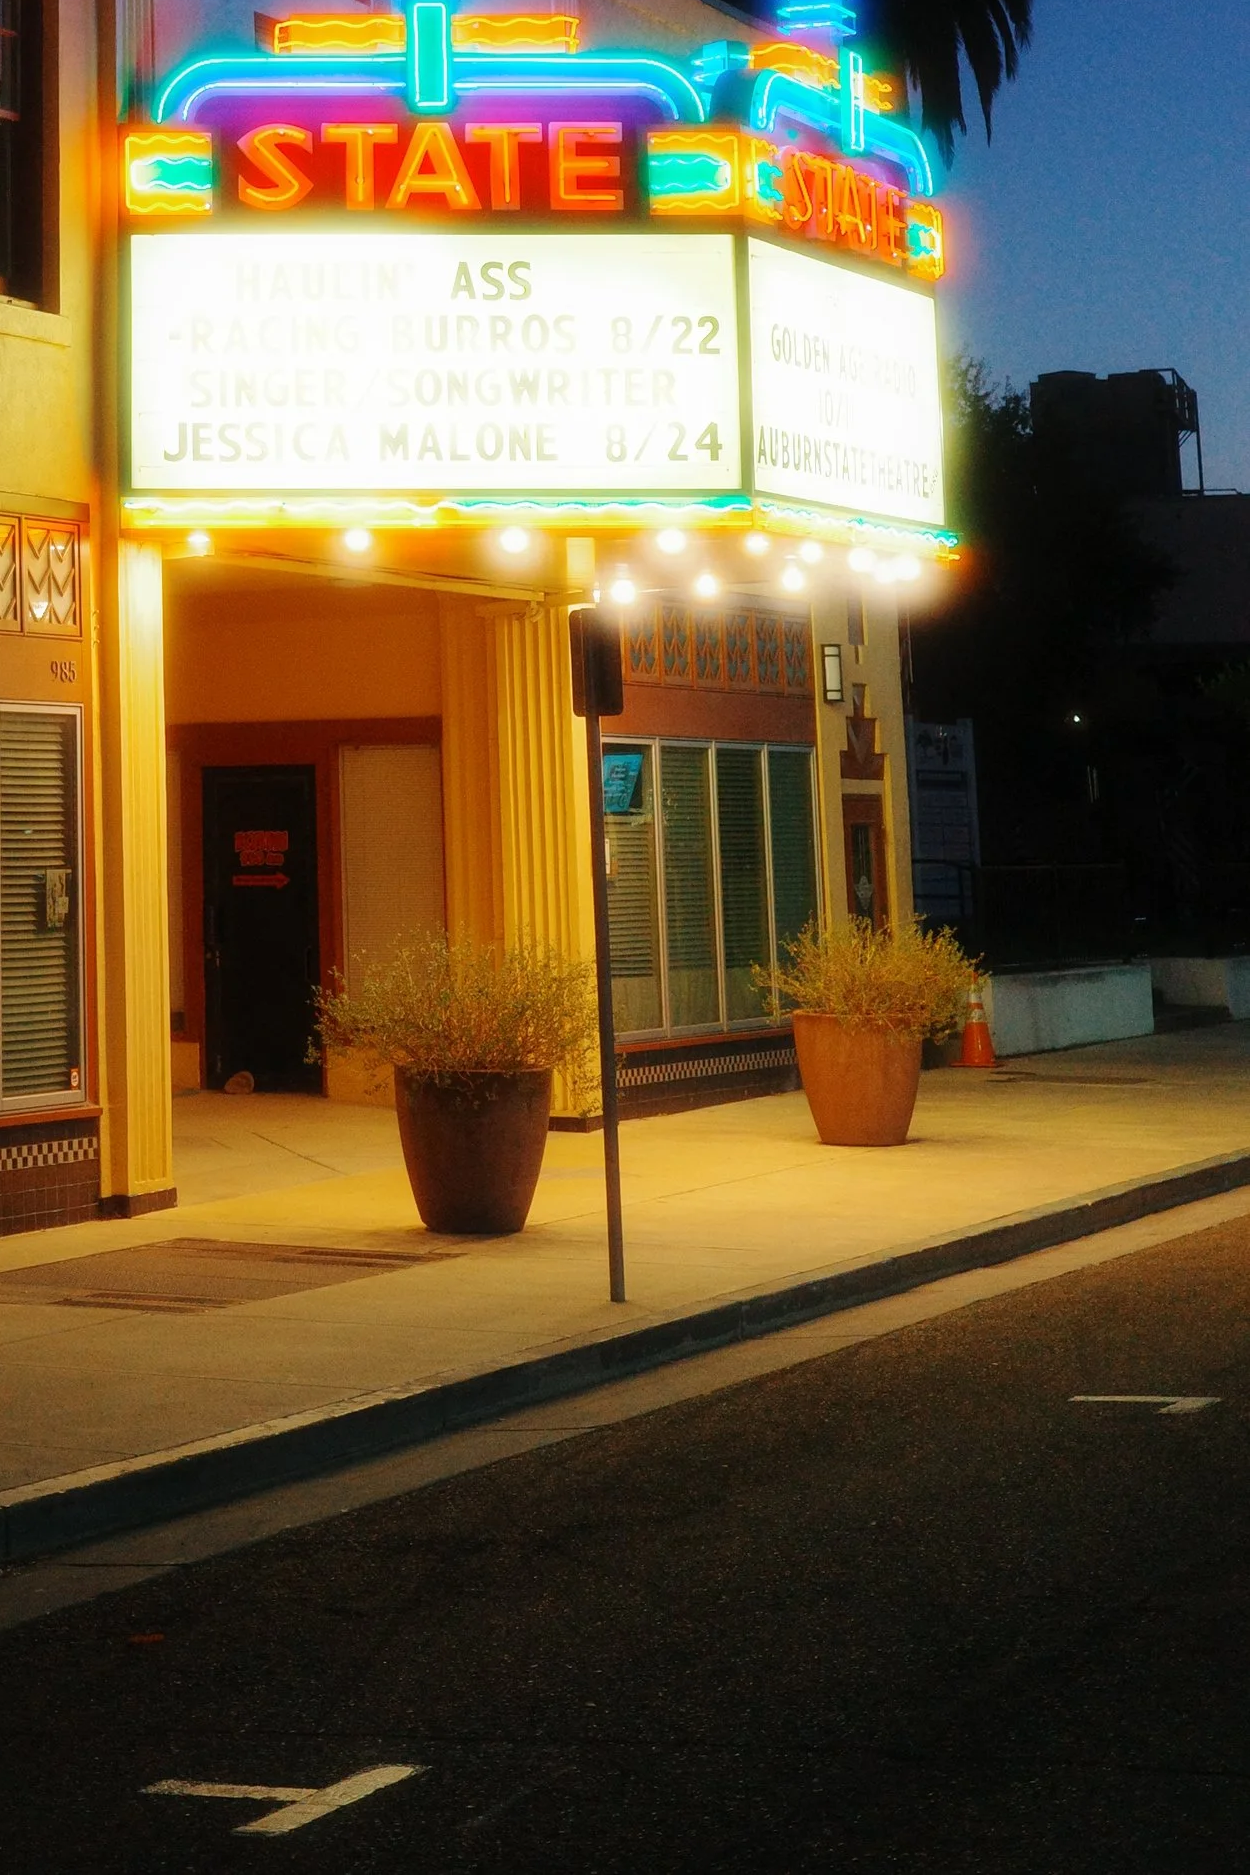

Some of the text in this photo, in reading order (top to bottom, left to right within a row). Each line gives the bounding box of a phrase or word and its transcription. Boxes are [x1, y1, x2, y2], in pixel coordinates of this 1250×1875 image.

[236, 121, 625, 212] STATE
[780, 147, 908, 267] STATE
[449, 260, 534, 302] ASS
[390, 314, 578, 356] BURROS
[610, 315, 723, 356] 8/22
[770, 323, 831, 375] GOLDEN
[188, 367, 679, 408] SINGER/SONGWRITER
[162, 421, 724, 463] JESSICA MALONE 8/24
[50, 660, 77, 683] 985
